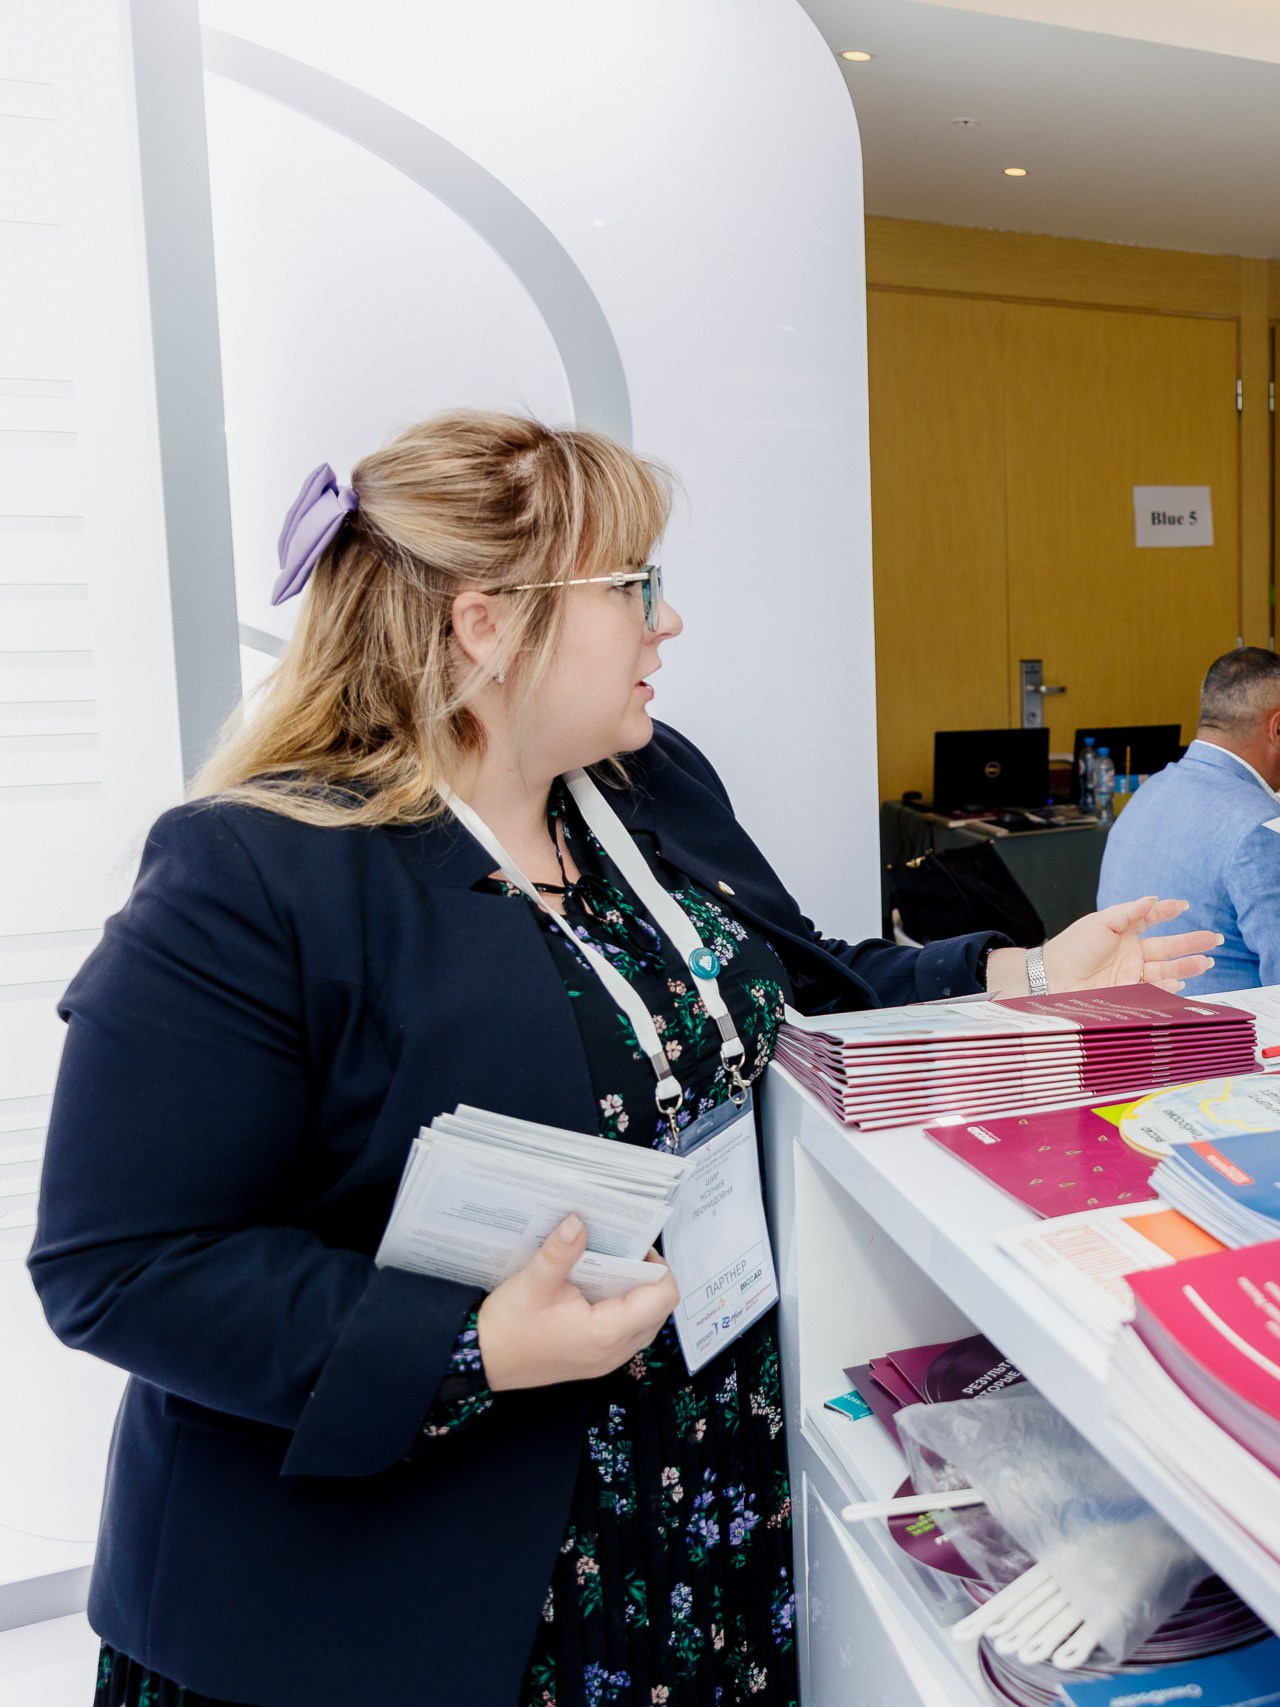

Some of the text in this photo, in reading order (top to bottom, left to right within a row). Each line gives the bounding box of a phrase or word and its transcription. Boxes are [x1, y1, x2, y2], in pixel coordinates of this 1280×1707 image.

[1151, 511, 1198, 526] Blue 5
[693, 1185, 734, 1220] ЛЕОНИДОВНА
[700, 1179, 725, 1201] КСЕНИЯ
[705, 1259, 747, 1299] ПАРТНЕР
[740, 1268, 763, 1292] BIOCAD
[973, 1371, 1021, 1397] ОТОРЫЕ
